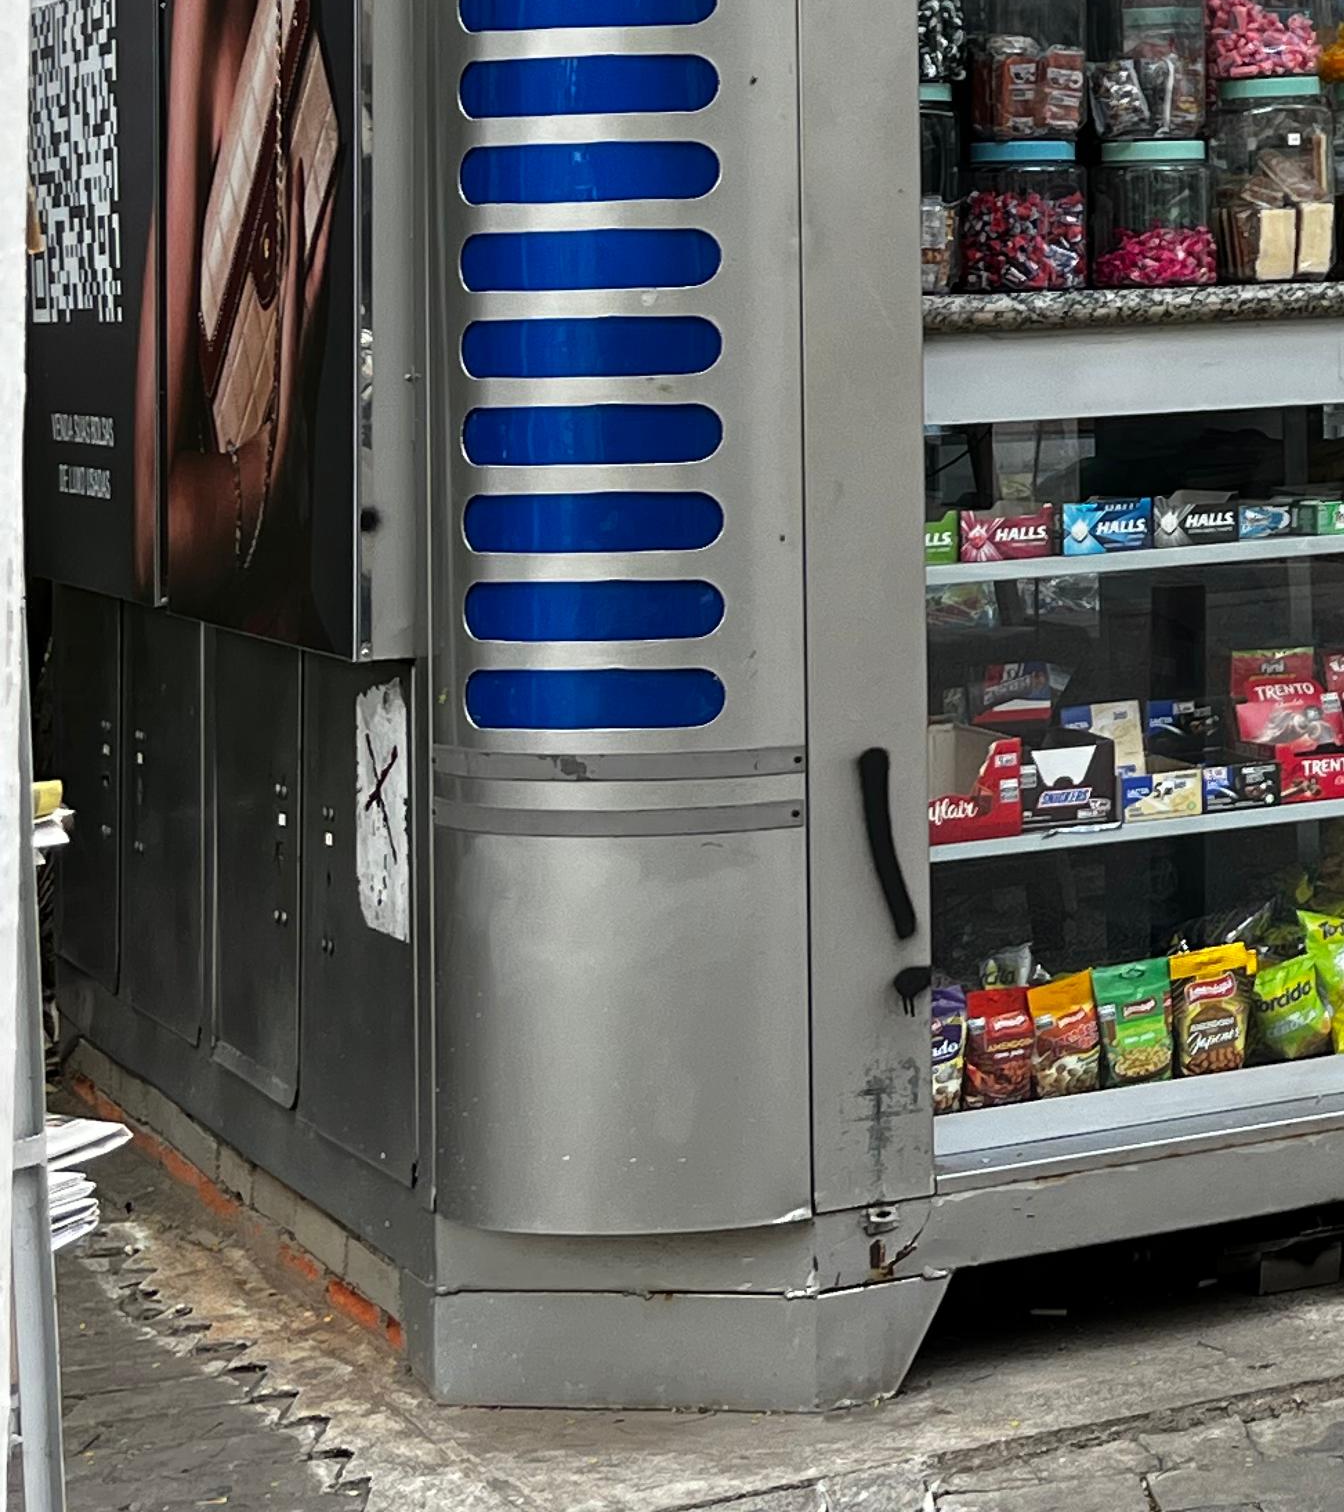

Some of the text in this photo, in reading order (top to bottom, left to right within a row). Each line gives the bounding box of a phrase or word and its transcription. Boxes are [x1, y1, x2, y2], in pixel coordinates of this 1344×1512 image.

[1095, 518, 1146, 536] HALLS
[1186, 511, 1235, 528] HALLS
[995, 525, 1048, 542] HALLS
[1255, 682, 1315, 701] TRENTO
